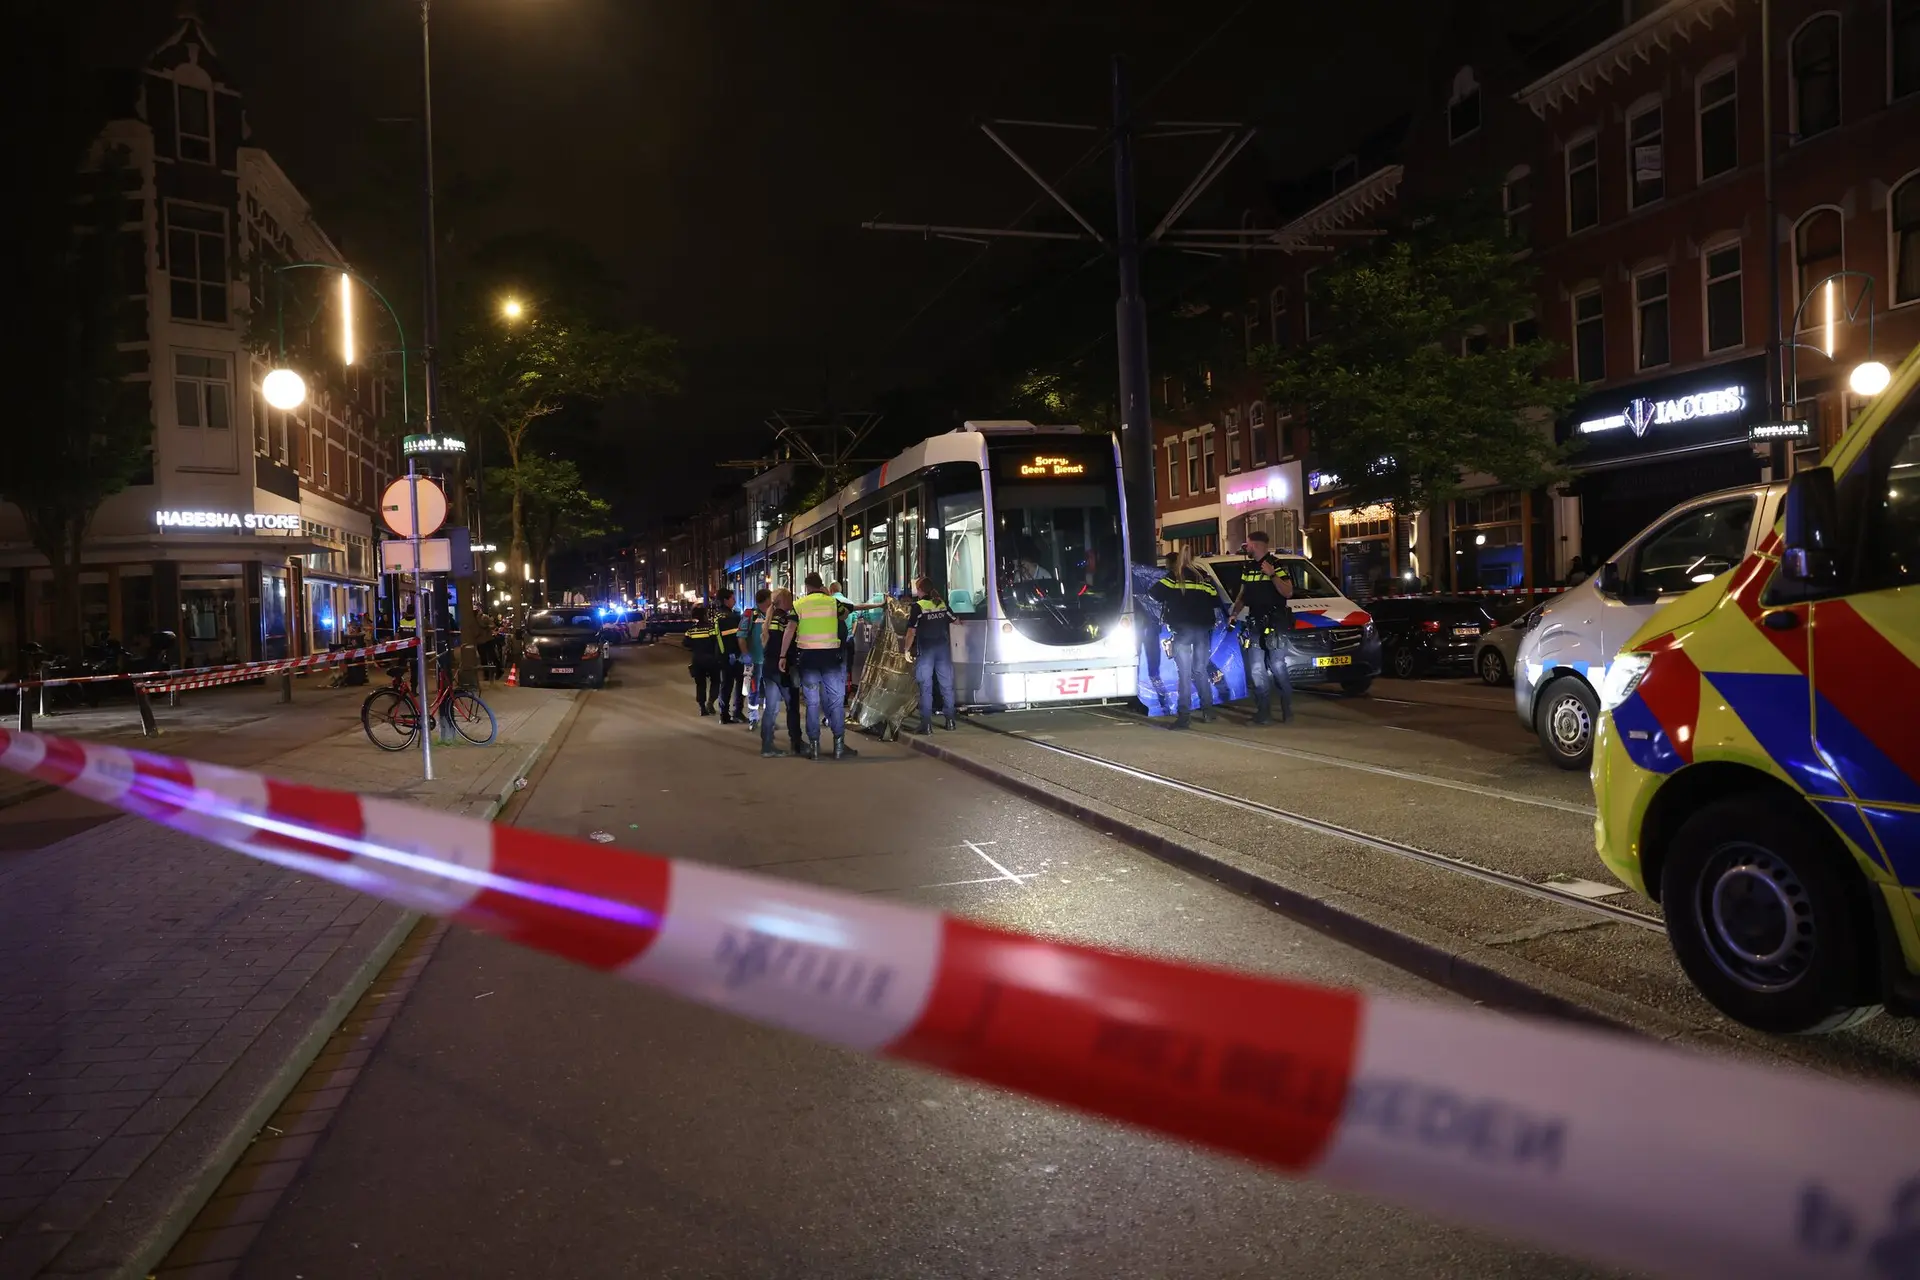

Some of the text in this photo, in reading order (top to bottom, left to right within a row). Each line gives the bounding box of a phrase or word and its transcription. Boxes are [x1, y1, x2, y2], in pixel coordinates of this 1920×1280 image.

[1035, 456, 1069, 466] Sorry,
[1021, 464, 1083, 475] Geen Dienst
[156, 511, 300, 529] HABESHA STORE
[1056, 676, 1095, 695] RET
